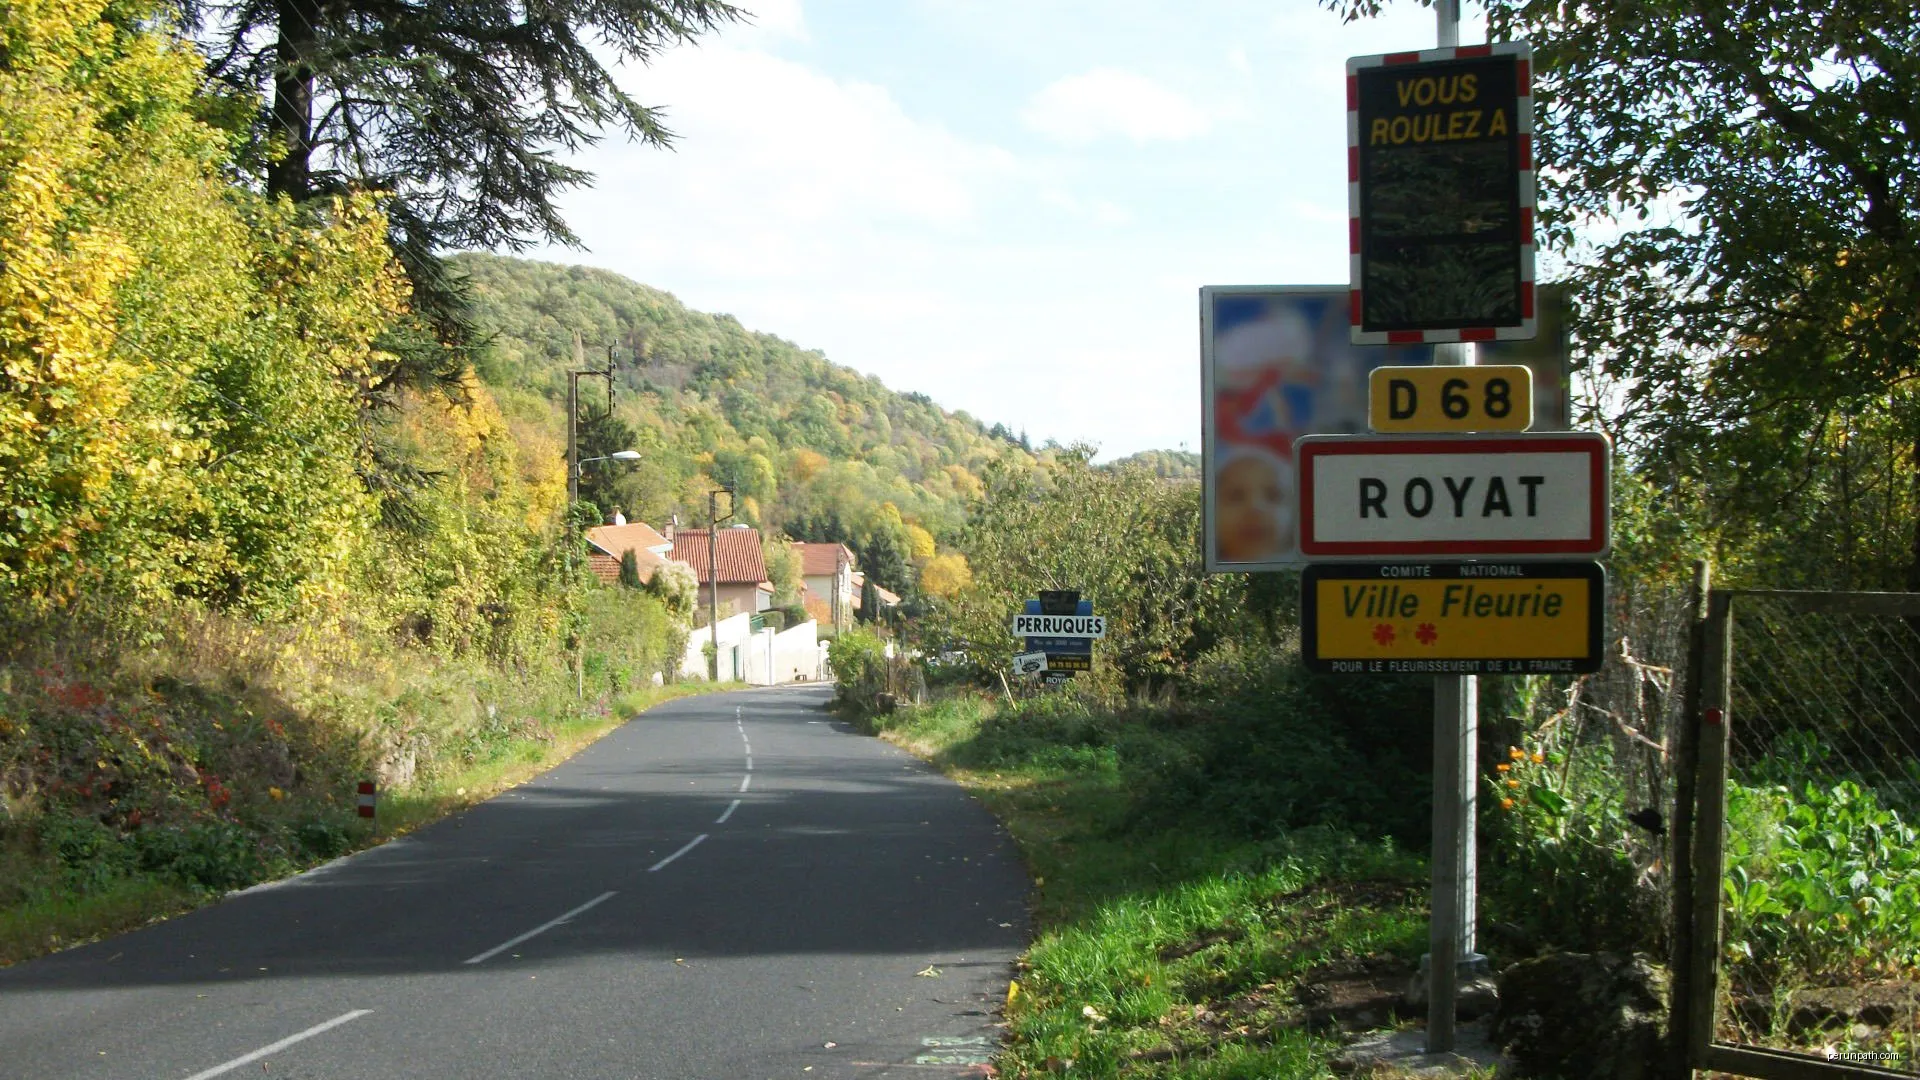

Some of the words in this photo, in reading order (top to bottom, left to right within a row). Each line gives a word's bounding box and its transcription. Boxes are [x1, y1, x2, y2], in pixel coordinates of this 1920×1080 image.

[1397, 73, 1478, 108] VOUS
[1370, 110, 1480, 146] ROULEZ
[1488, 108, 1508, 137] A
[1388, 379, 1418, 421] D
[1440, 377, 1513, 420] 68
[1358, 475, 1545, 519] ROYAT
[1380, 564, 1432, 577] COMITÉ
[1459, 565, 1524, 577] NATIONAL
[1342, 584, 1420, 618] Ville
[1440, 583, 1564, 618] Fleurie
[1016, 617, 1103, 634] PERRUQUES
[1332, 661, 1363, 673] POUR
[1369, 661, 1382, 673] LE
[1388, 661, 1481, 673] FLEURISSEMENT
[1487, 660, 1502, 672] DE
[1508, 660, 1523, 672] LA
[1529, 659, 1574, 671] FRANCE
